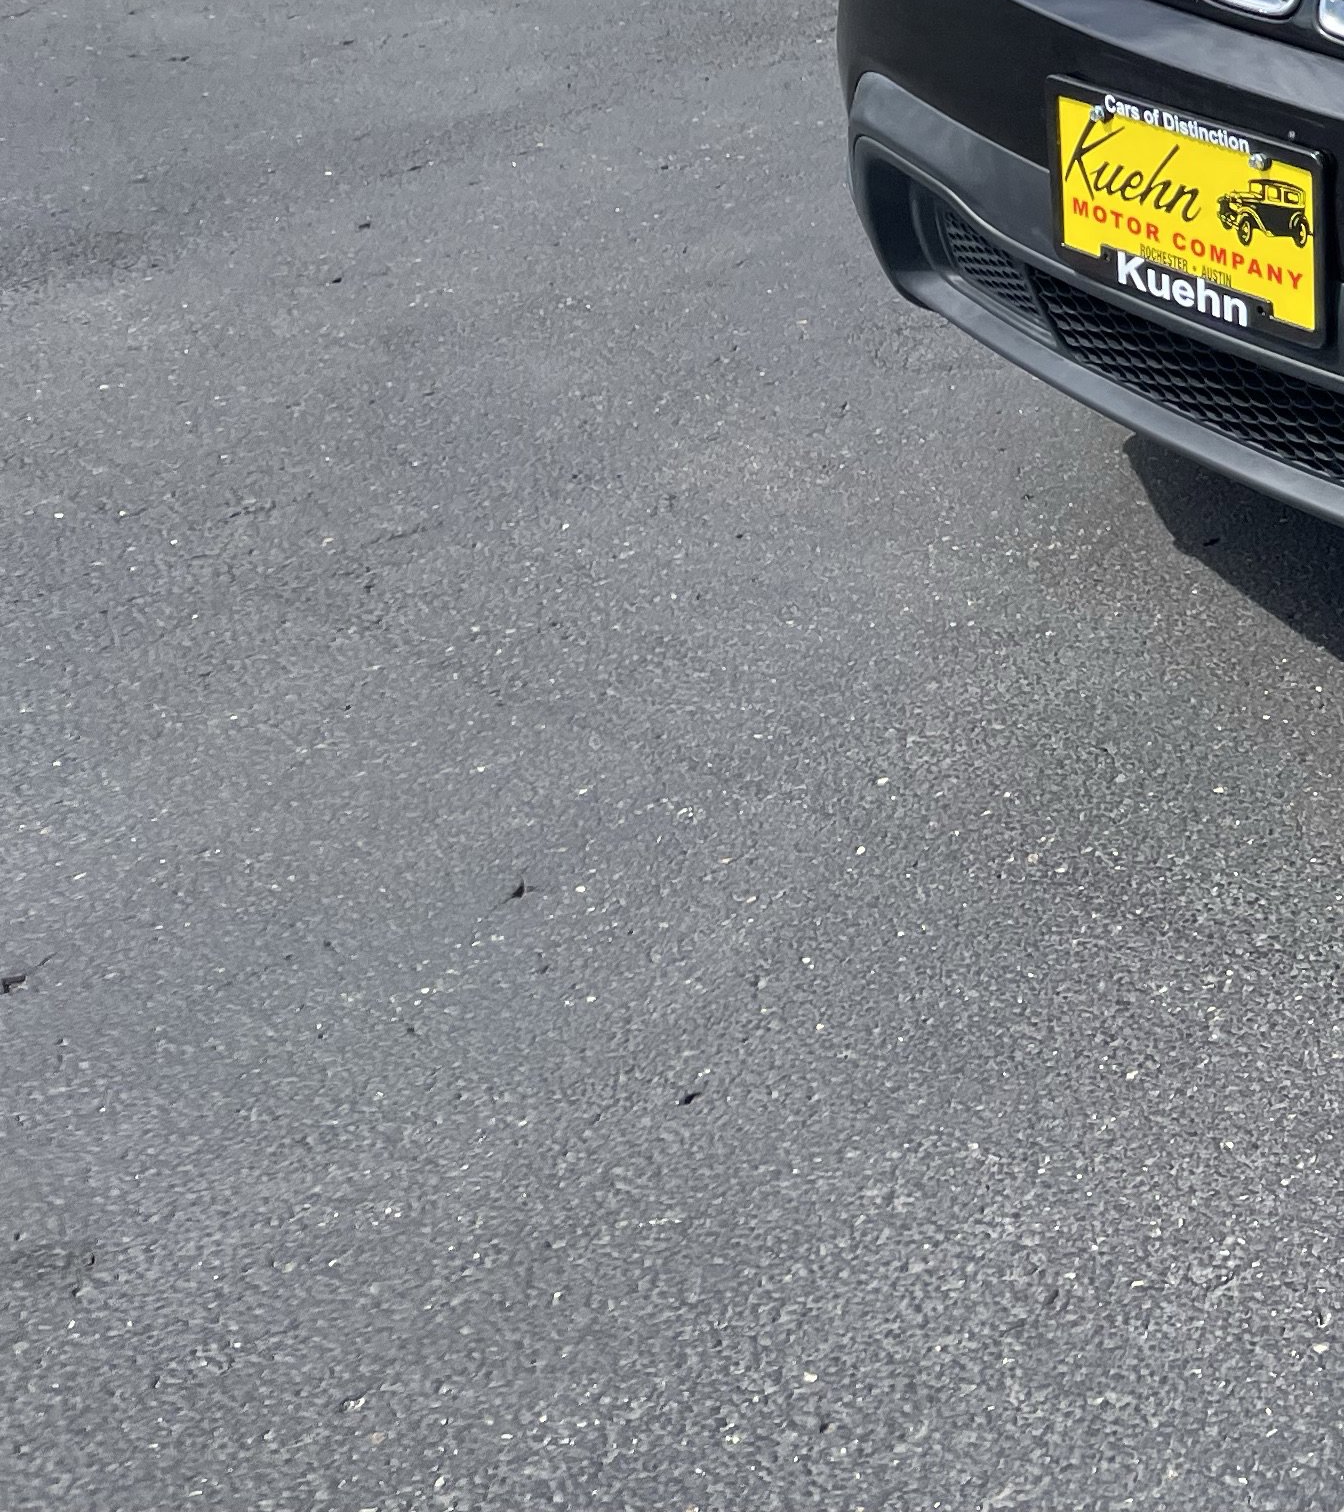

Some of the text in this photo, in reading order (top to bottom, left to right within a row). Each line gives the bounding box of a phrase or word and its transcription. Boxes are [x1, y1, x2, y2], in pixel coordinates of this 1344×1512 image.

[1104, 94, 1250, 154] Cars of Distinction
[1064, 119, 1202, 223] Kuehn
[1072, 197, 1304, 290] MOTOR COMPANY
[1140, 244, 1232, 288] ROCHESTER AUSTIN
[1117, 251, 1248, 328] Kuehn
